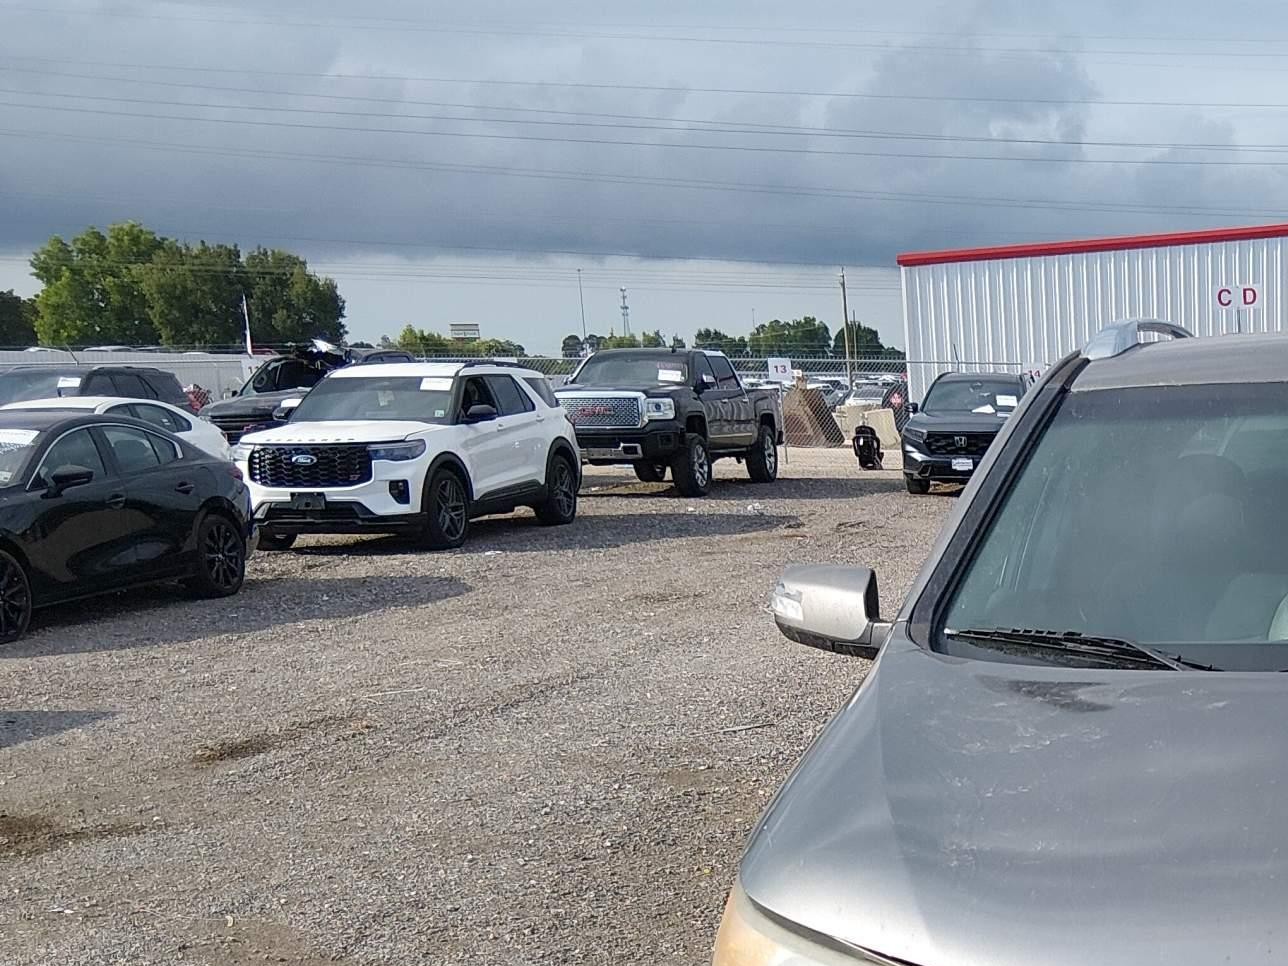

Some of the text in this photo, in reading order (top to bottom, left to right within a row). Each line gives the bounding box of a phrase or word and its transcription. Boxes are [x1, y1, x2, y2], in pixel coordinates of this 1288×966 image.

[1217, 287, 1257, 306] C D
[773, 365, 787, 374] 13
